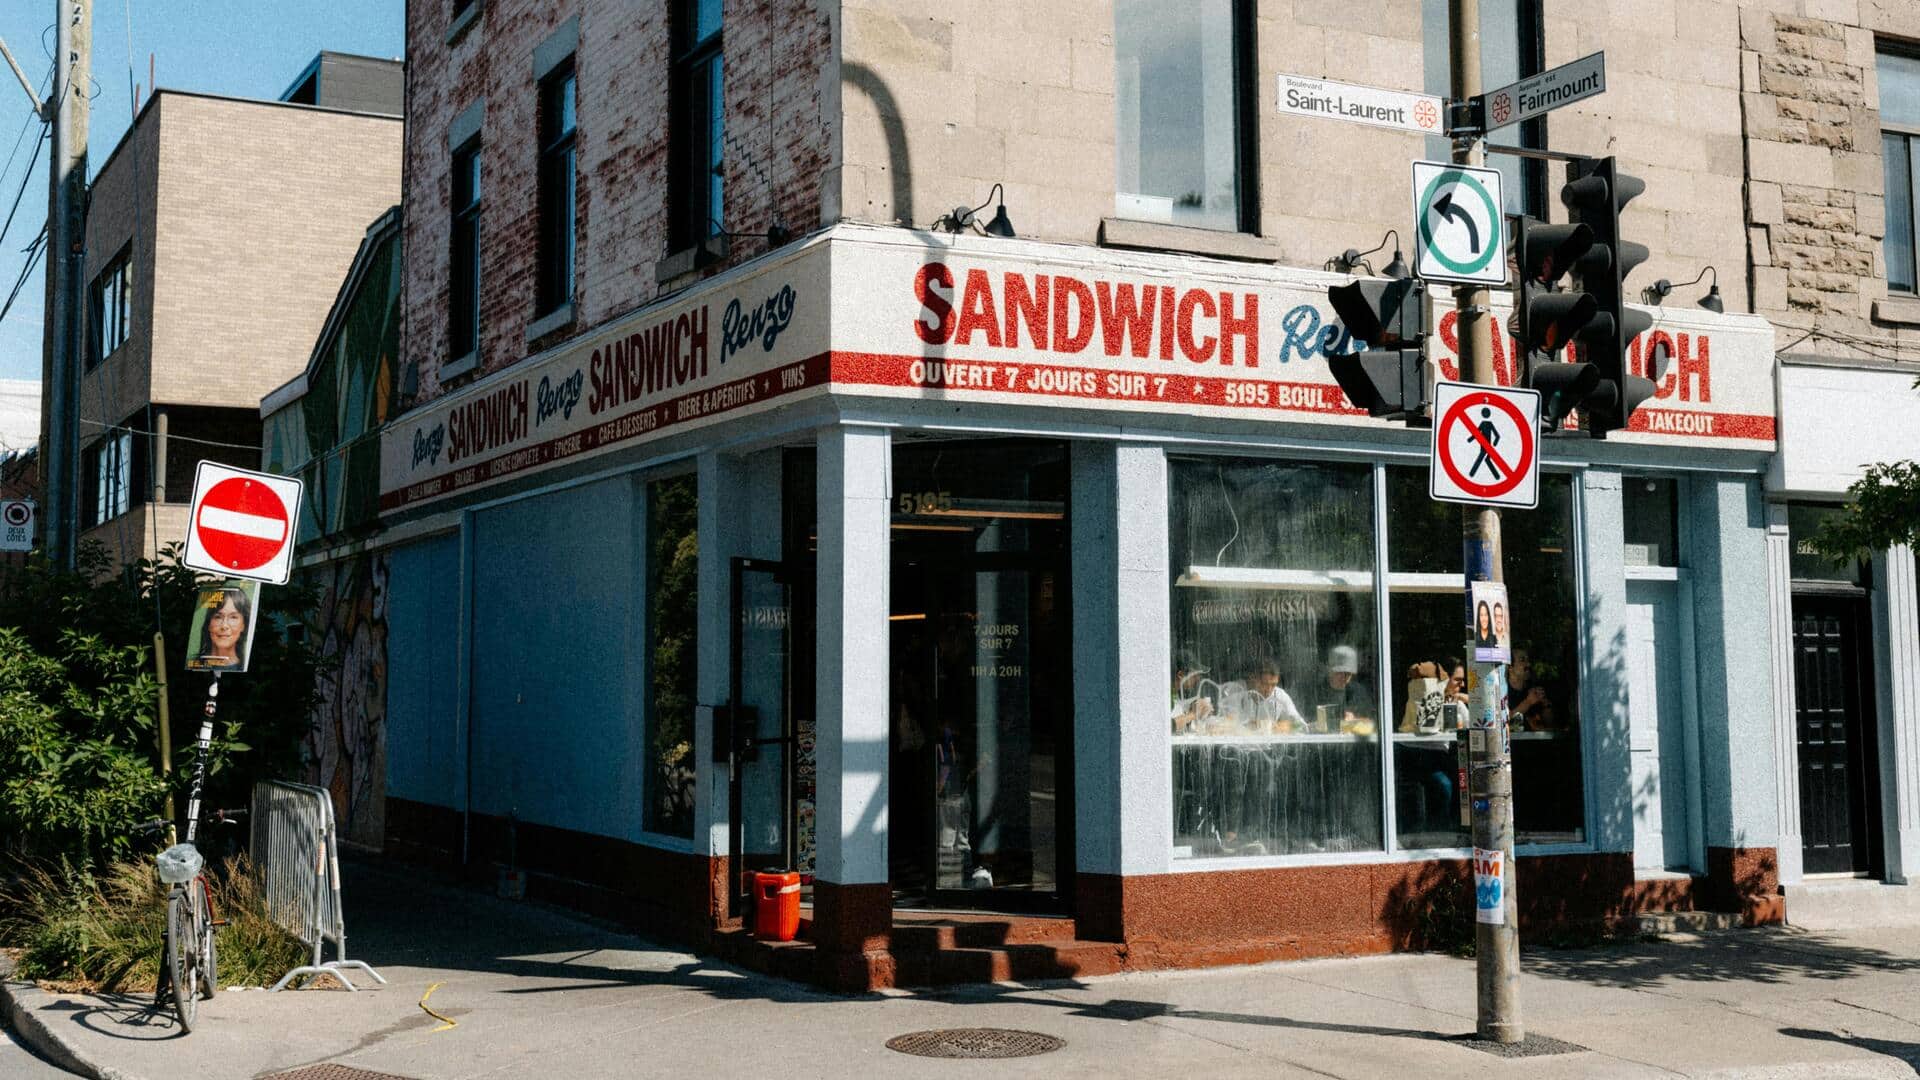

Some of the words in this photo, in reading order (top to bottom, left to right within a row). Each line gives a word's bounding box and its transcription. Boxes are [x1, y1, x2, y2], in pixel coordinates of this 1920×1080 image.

[1286, 78, 1322, 90] Boulevard
[1545, 74, 1556, 83] est
[1519, 71, 1599, 114] Fairmount
[1286, 88, 1405, 124] Saint-Laurent
[914, 262, 1259, 367] SANDWICH
[412, 422, 446, 471] Renzo
[448, 380, 529, 464] SANDWICH
[536, 368, 584, 427] Renzo
[588, 304, 709, 415] SANDWICH
[720, 284, 797, 364] Renzo
[781, 364, 806, 389] VINS
[909, 360, 997, 387] OUVERT
[1005, 367, 1019, 389] 7
[1026, 368, 1097, 394] JOURS
[1107, 373, 1147, 397] SUR
[1154, 378, 1168, 397] 7
[702, 392, 711, 413] &
[1225, 383, 1269, 405] 5195
[1278, 386, 1333, 409] BOUL.
[616, 420, 622, 438] &
[622, 409, 657, 436] DESSERTS
[1646, 411, 1714, 433] TAKEOUT
[900, 491, 952, 513] 5195
[974, 624, 981, 636] 7
[982, 624, 1019, 637] JOURS
[980, 638, 1003, 650] SUR
[1005, 638, 1013, 650] 7
[999, 664, 1022, 678] 20H
